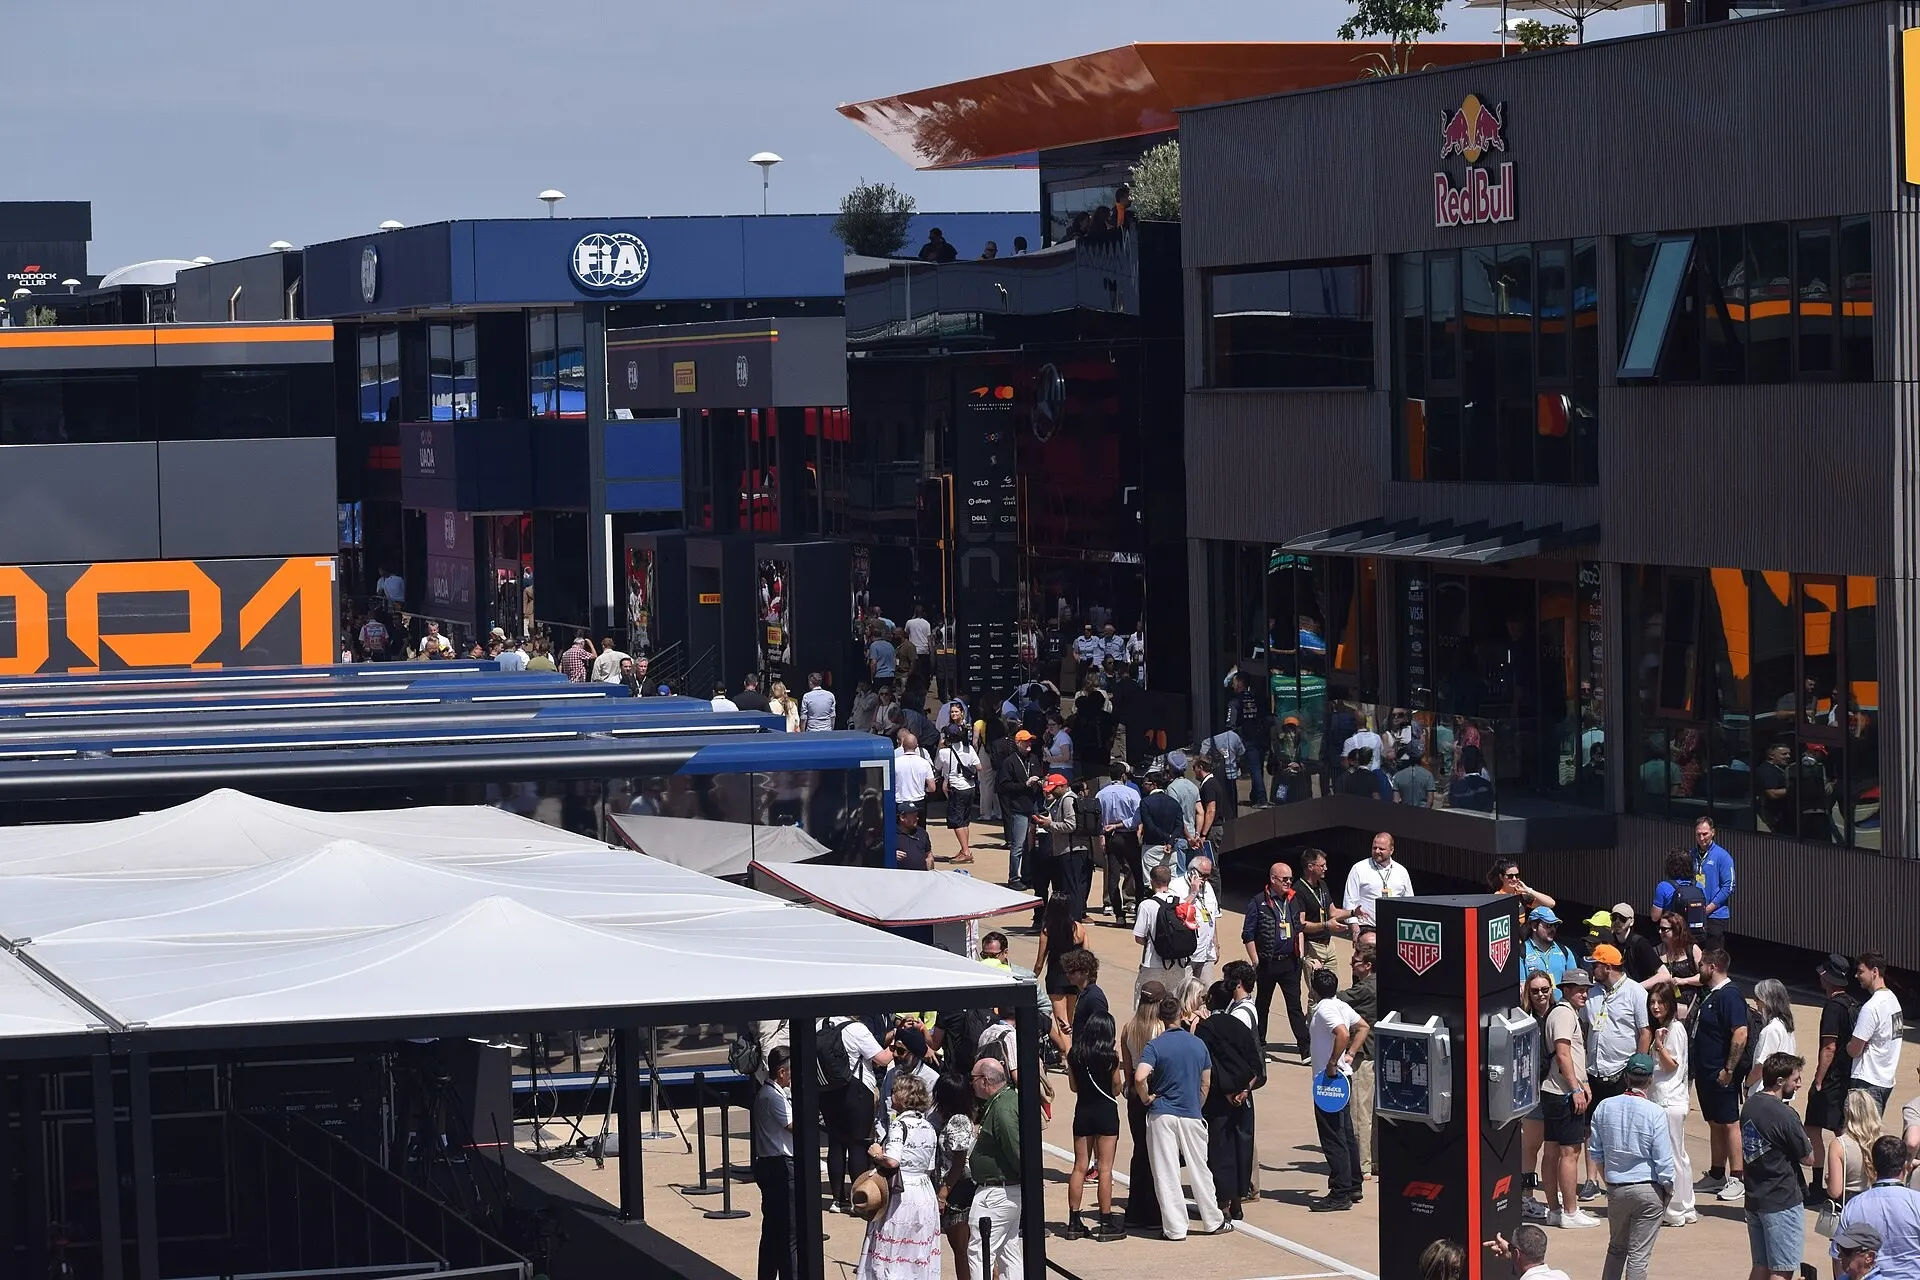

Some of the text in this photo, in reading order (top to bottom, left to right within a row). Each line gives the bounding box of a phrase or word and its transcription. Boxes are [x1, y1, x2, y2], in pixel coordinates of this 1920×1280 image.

[1434, 162, 1514, 227] Red Bull
[972, 479, 990, 487] VELO
[1410, 606, 1424, 620] VISA
[1401, 922, 1437, 942] TAG
[1491, 919, 1509, 939] TAG
[1399, 943, 1438, 971] HEUER
[1490, 940, 1510, 970] HEUER
